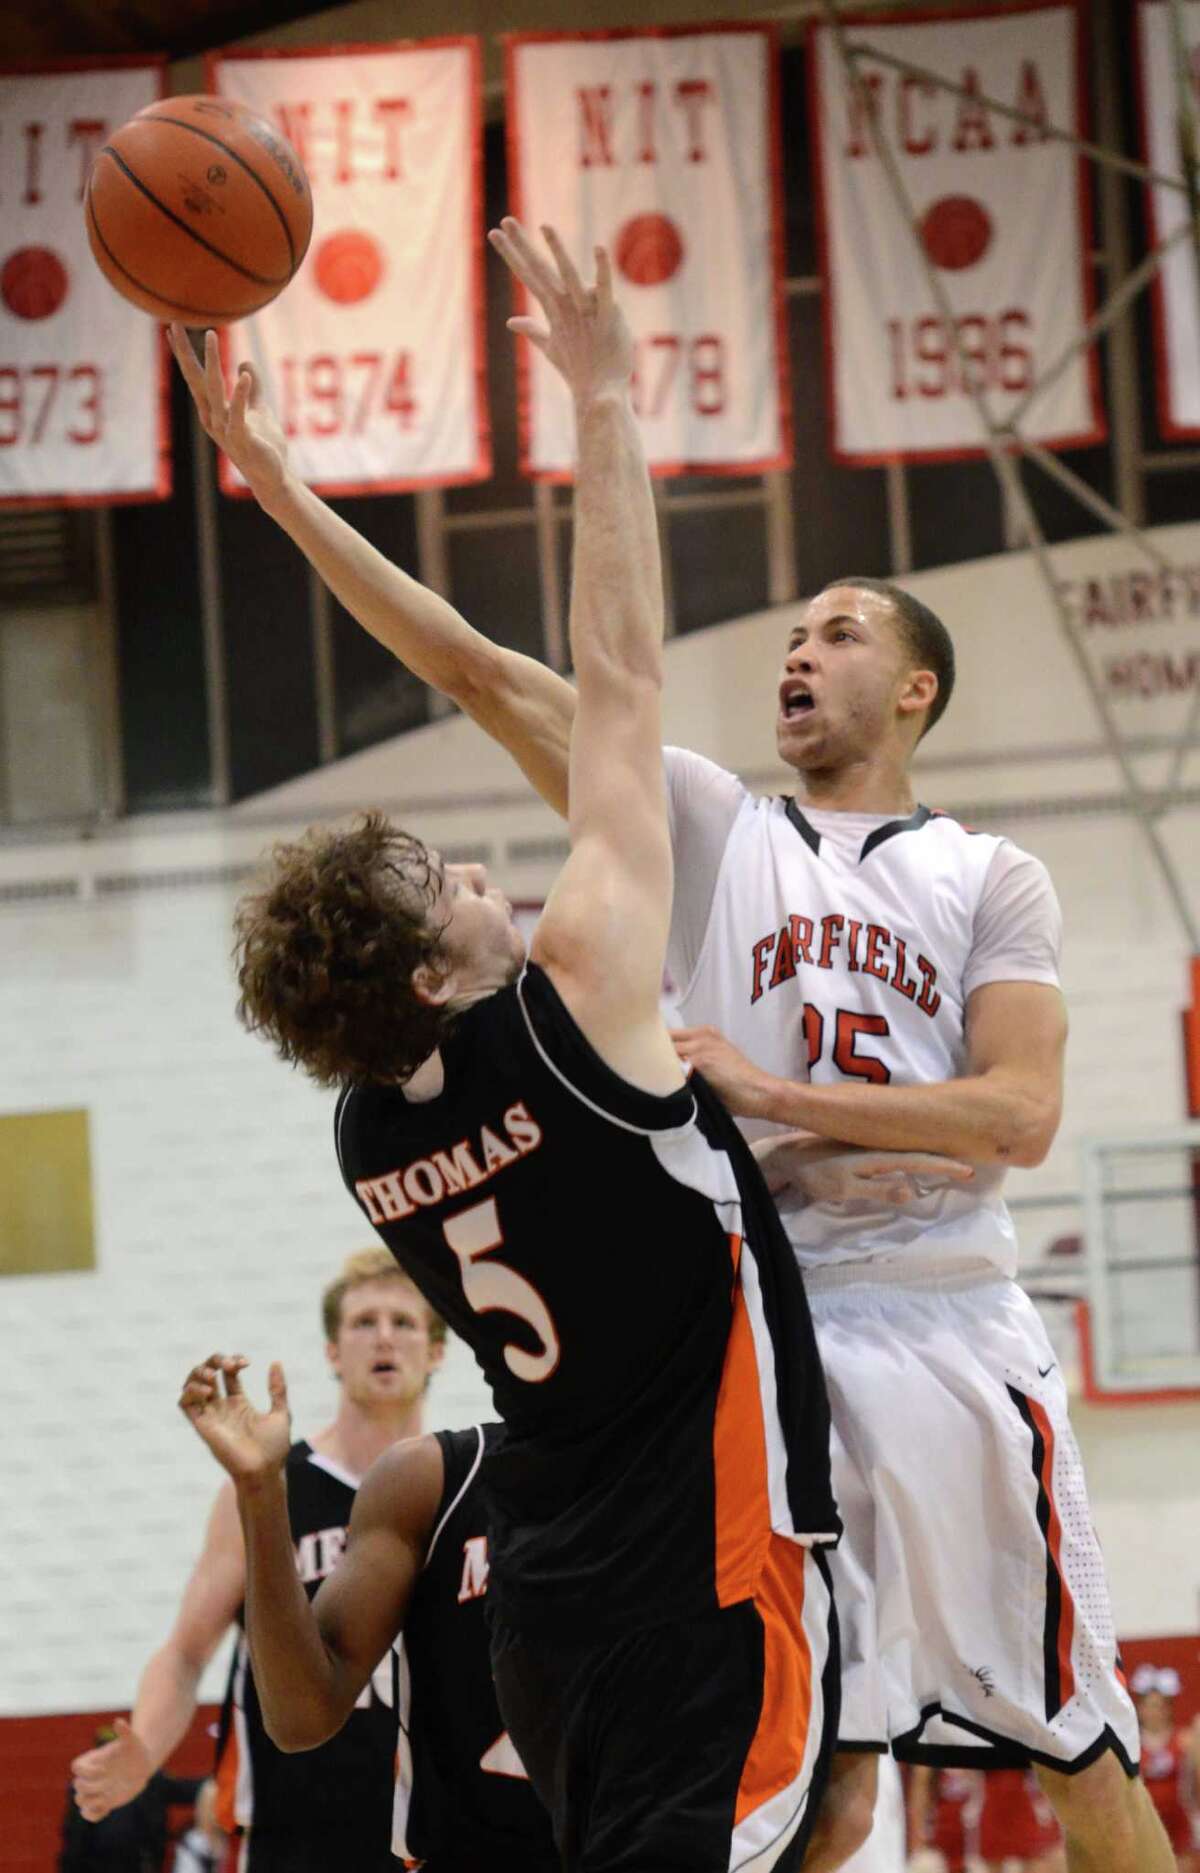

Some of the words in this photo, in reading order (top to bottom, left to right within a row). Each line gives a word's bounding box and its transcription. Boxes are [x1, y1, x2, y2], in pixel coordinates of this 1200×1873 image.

[274, 97, 413, 184] NIT
[577, 81, 714, 167] NIT
[845, 60, 1051, 160] NCAA
[22, 119, 109, 206] IT
[282, 349, 416, 438] 1974
[886, 309, 1034, 402] 1986
[0, 366, 104, 447] 973
[751, 913, 942, 1018] FARFIELD
[355, 1099, 544, 1225] THOMAS
[442, 1194, 560, 1384] 5
